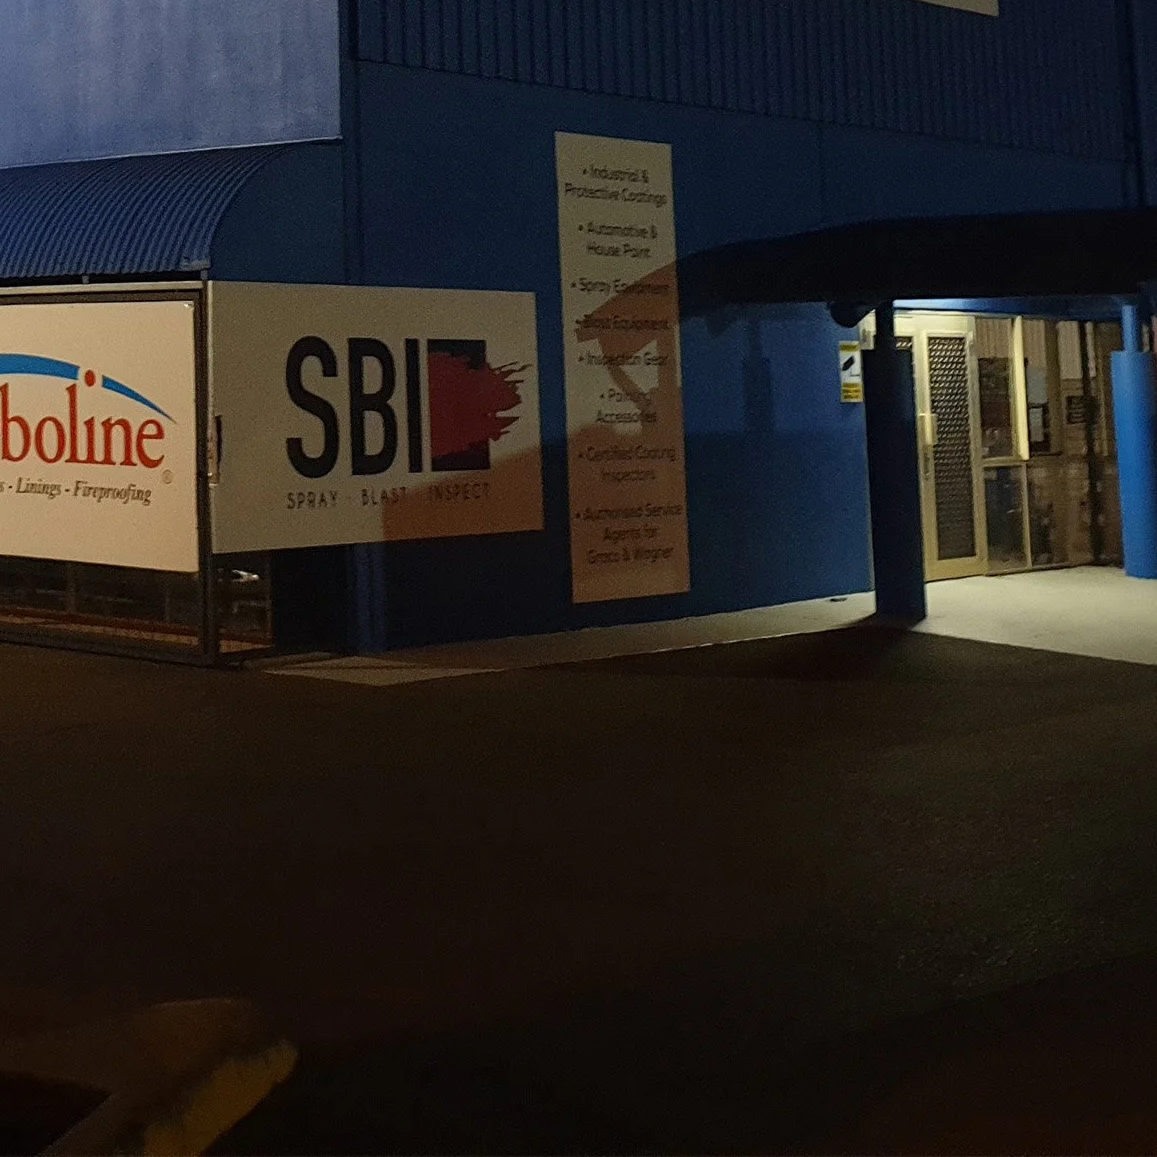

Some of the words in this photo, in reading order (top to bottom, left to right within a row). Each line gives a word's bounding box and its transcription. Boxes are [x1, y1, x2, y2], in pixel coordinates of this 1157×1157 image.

[565, 182, 620, 200] Protective
[622, 188, 667, 208] Coatings
[588, 222, 648, 239] Automotive
[587, 242, 620, 257] House
[579, 278, 611, 294] Spray
[613, 279, 669, 295] Equipment
[613, 315, 669, 331] Equipment
[643, 351, 668, 366] Gear
[286, 336, 423, 478] SBI
[596, 410, 657, 423] Accessories
[635, 445, 676, 462] Coating
[16, 476, 62, 500] Linings
[74, 480, 152, 506] Fireproofing
[286, 489, 338, 510] SPRAY
[361, 486, 407, 507] BLAST
[428, 482, 492, 503] INSPECT
[645, 503, 682, 518] Service
